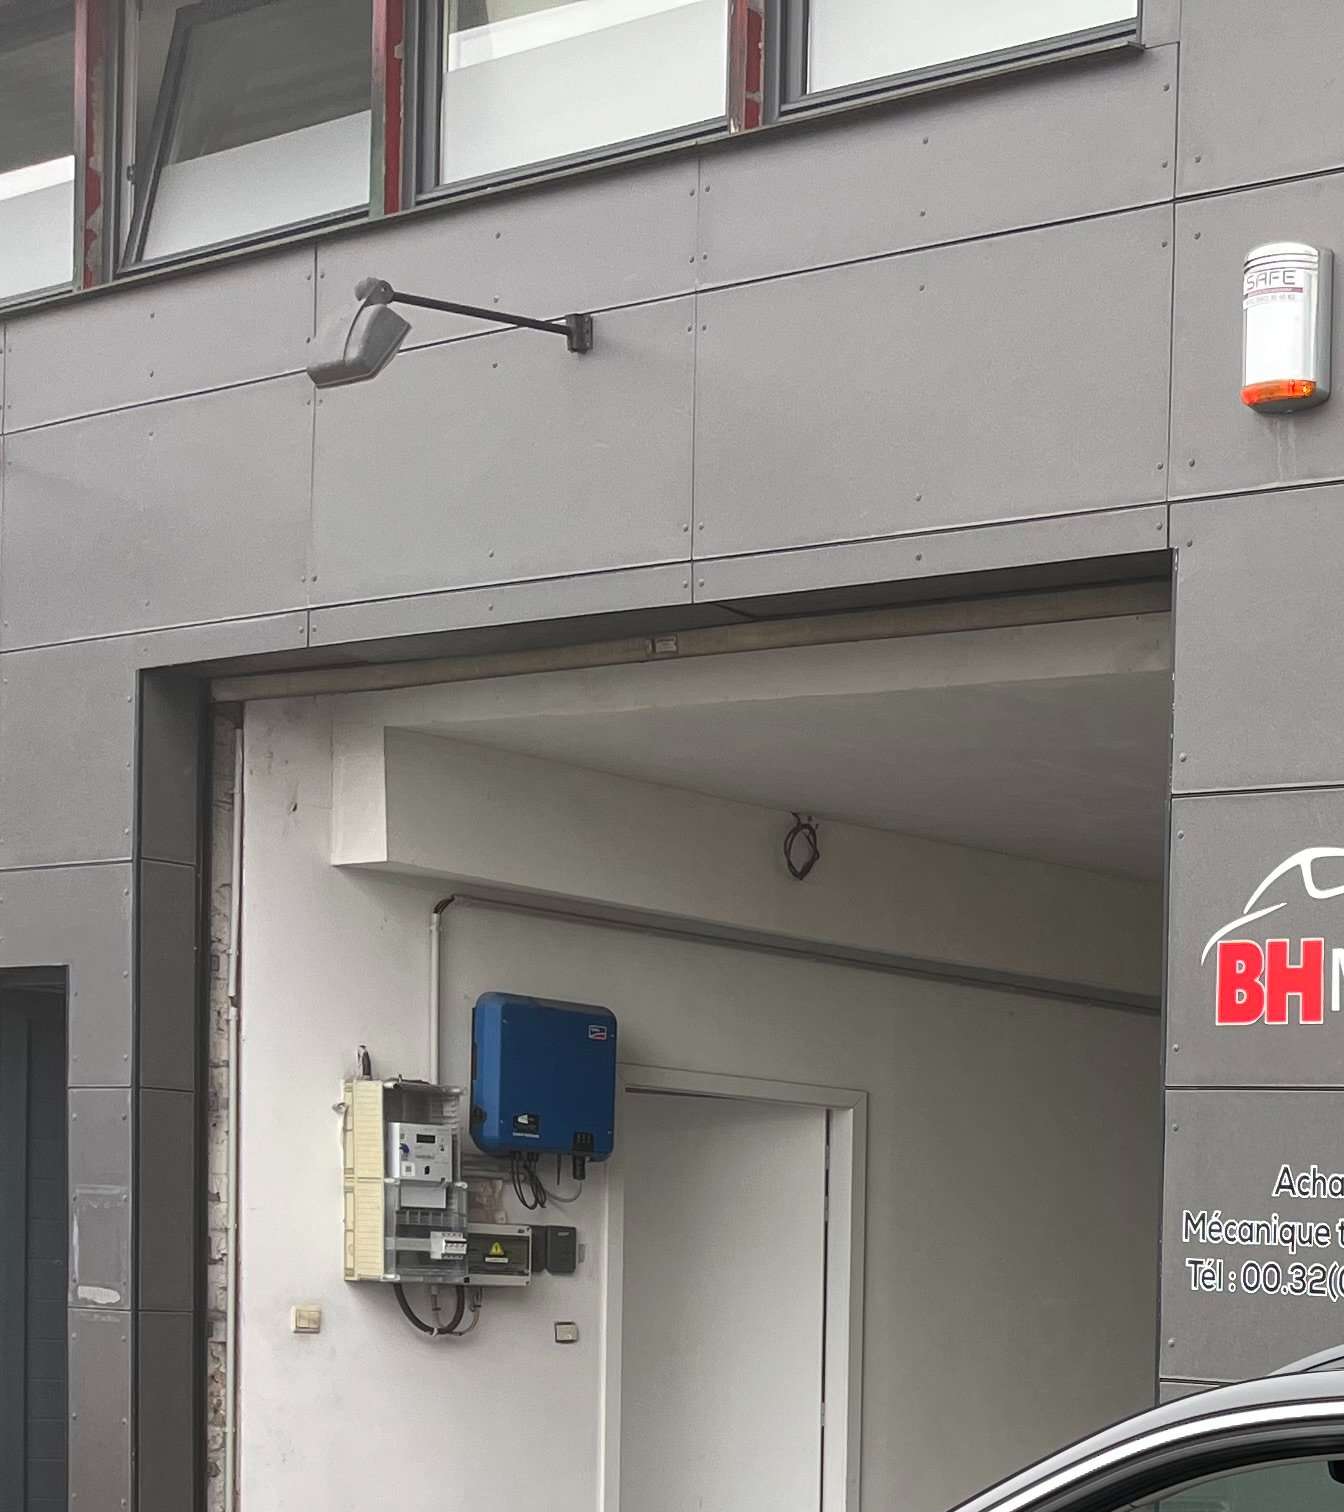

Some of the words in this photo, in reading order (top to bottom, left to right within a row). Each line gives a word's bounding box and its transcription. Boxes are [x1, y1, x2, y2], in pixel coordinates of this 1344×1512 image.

[1246, 269, 1297, 290] SAFE
[1215, 937, 1325, 1026] BH
[1182, 1210, 1331, 1254] Mécanique
